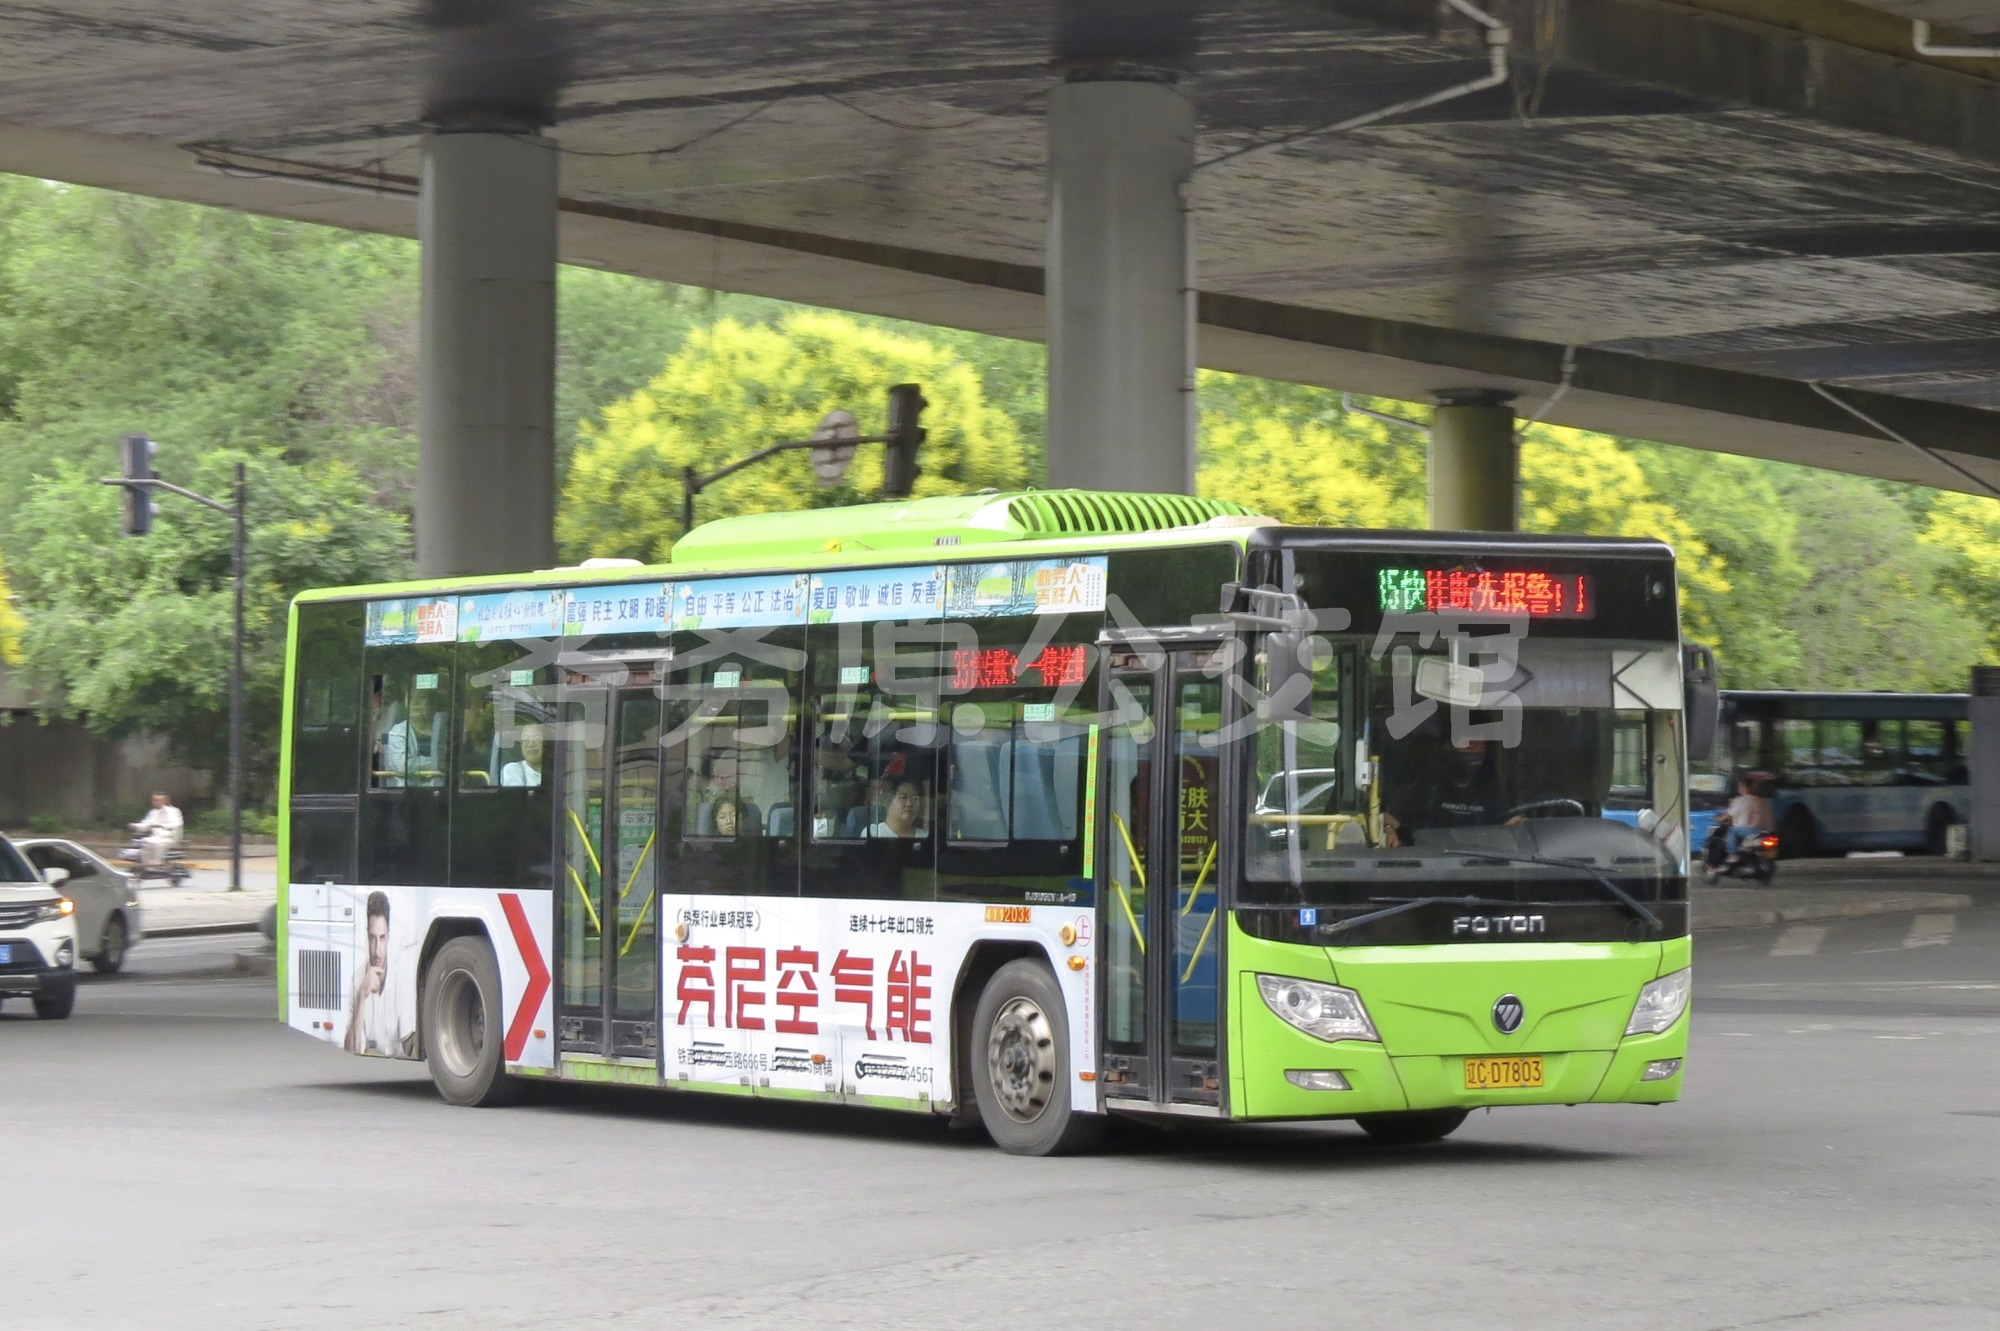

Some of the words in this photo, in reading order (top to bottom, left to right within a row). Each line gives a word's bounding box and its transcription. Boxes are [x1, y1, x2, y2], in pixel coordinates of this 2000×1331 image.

[566, 601, 590, 624] 富强
[592, 599, 613, 621] 民主
[617, 596, 640, 620] 文明
[644, 593, 669, 618] 和谐
[684, 594, 708, 618] 自由
[712, 591, 737, 615] 平等
[741, 589, 765, 614] 公正
[770, 587, 795, 613] 法治
[814, 587, 838, 610] 爱国
[846, 585, 870, 609] 敬业
[878, 582, 904, 606] 诚信
[910, 580, 938, 605] 友善
[849, 914, 934, 935] 连续十七年出口领先
[1453, 915, 1545, 934] FOTON
[677, 944, 932, 1044] 芬尼空气能
